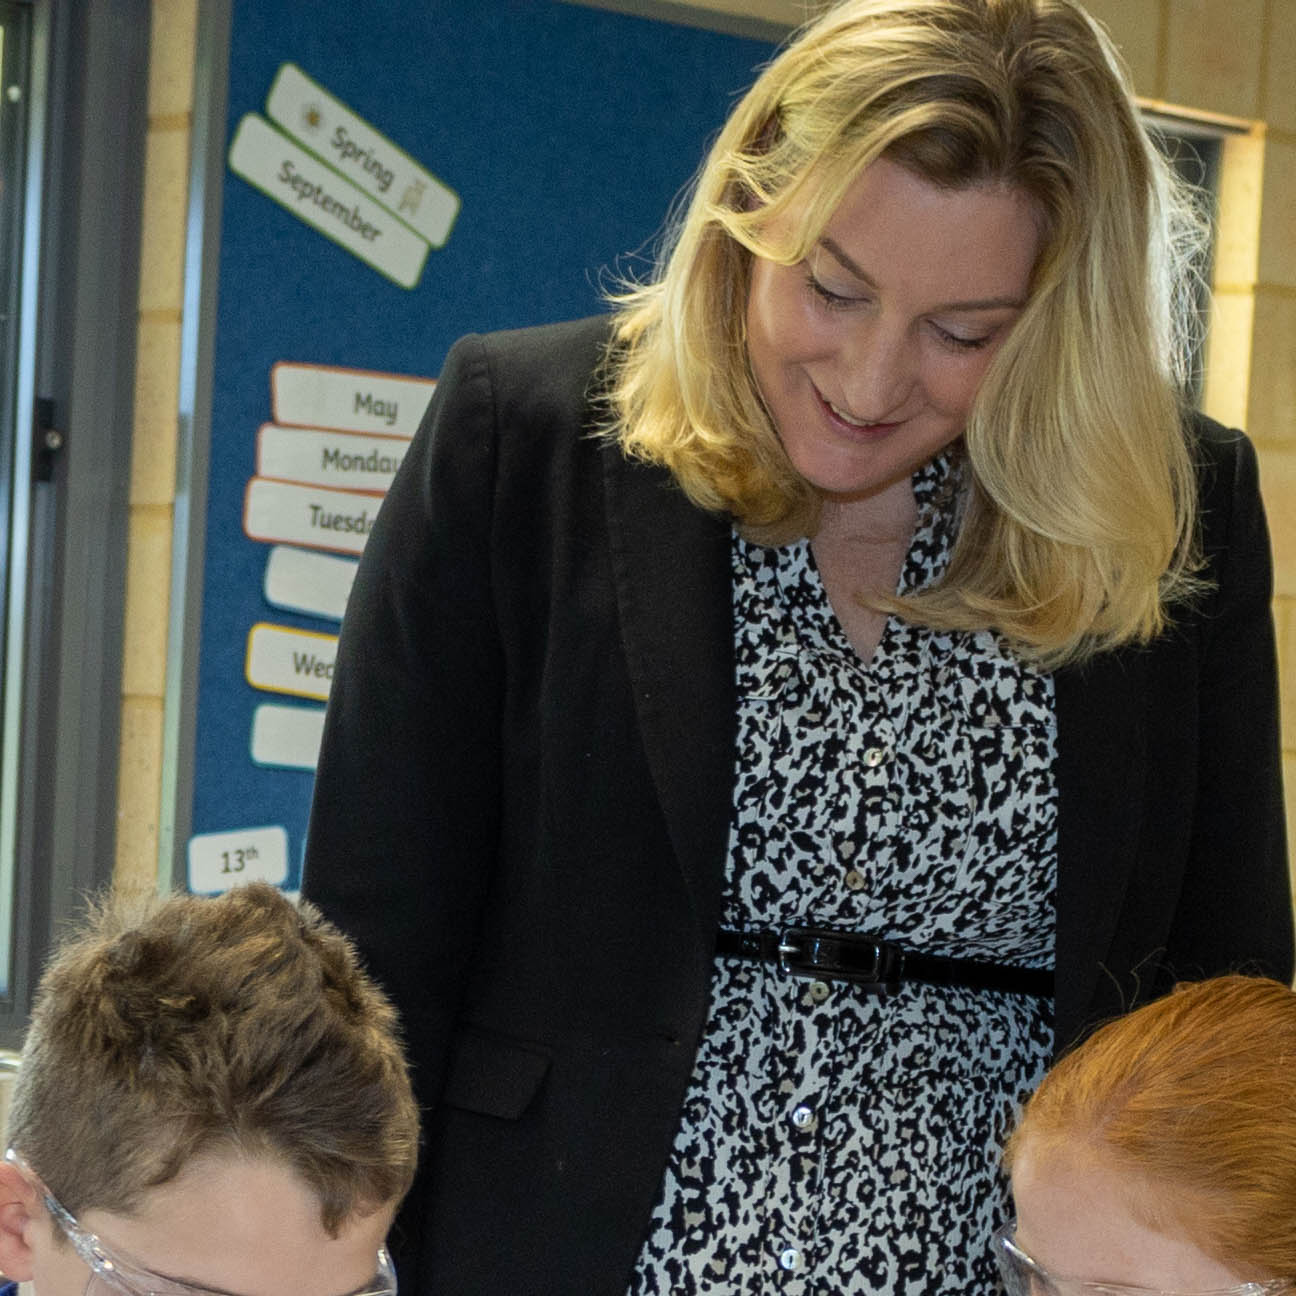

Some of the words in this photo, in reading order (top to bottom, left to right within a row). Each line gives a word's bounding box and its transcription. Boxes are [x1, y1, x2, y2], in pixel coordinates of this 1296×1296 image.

[330, 125, 396, 194] Spring
[277, 159, 383, 244] September
[353, 392, 399, 425] May
[220, 845, 260, 874] 13th
